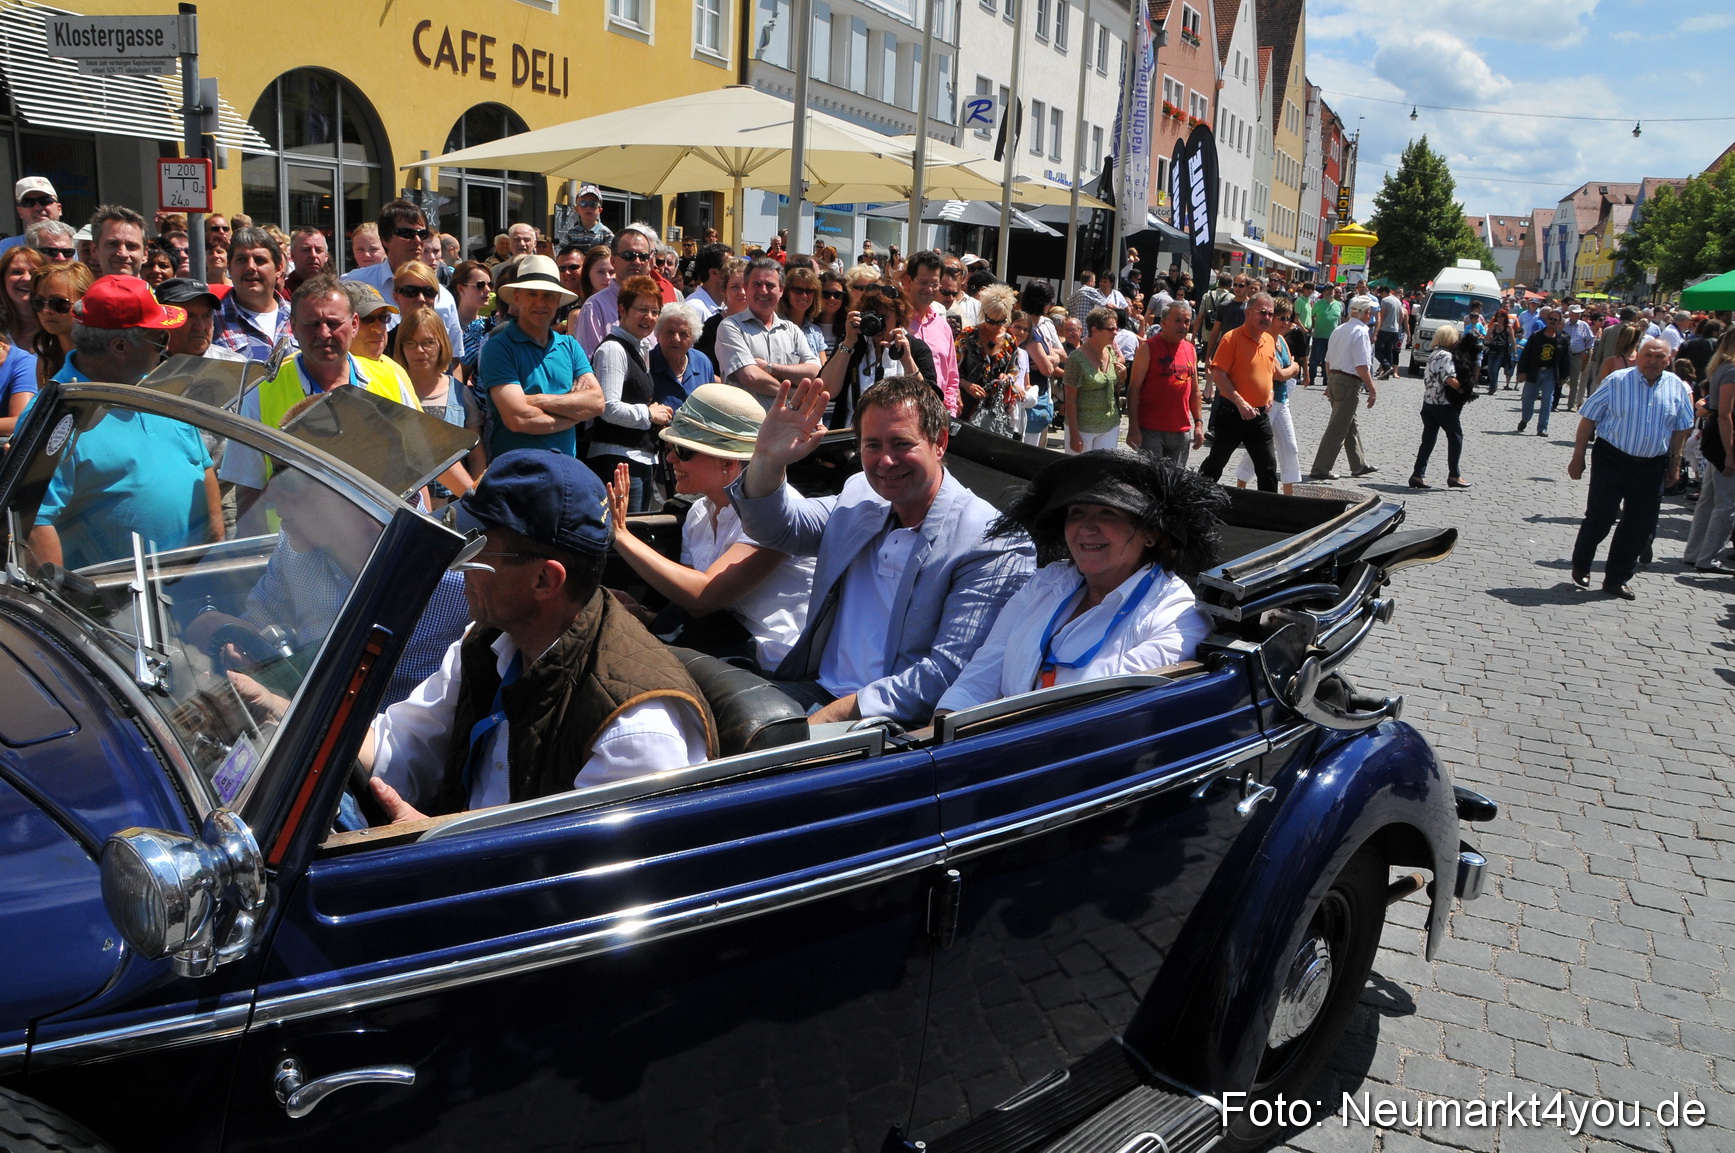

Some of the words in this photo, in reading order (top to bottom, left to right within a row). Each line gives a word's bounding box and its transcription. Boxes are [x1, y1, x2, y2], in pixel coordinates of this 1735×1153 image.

[54, 21, 164, 53] Klostergasse
[412, 19, 497, 80] CAFE
[511, 42, 569, 98] DELI
[164, 164, 171, 176] H
[177, 164, 196, 176] 200
[192, 180, 205, 194] 0,2
[171, 194, 190, 206] 24,0
